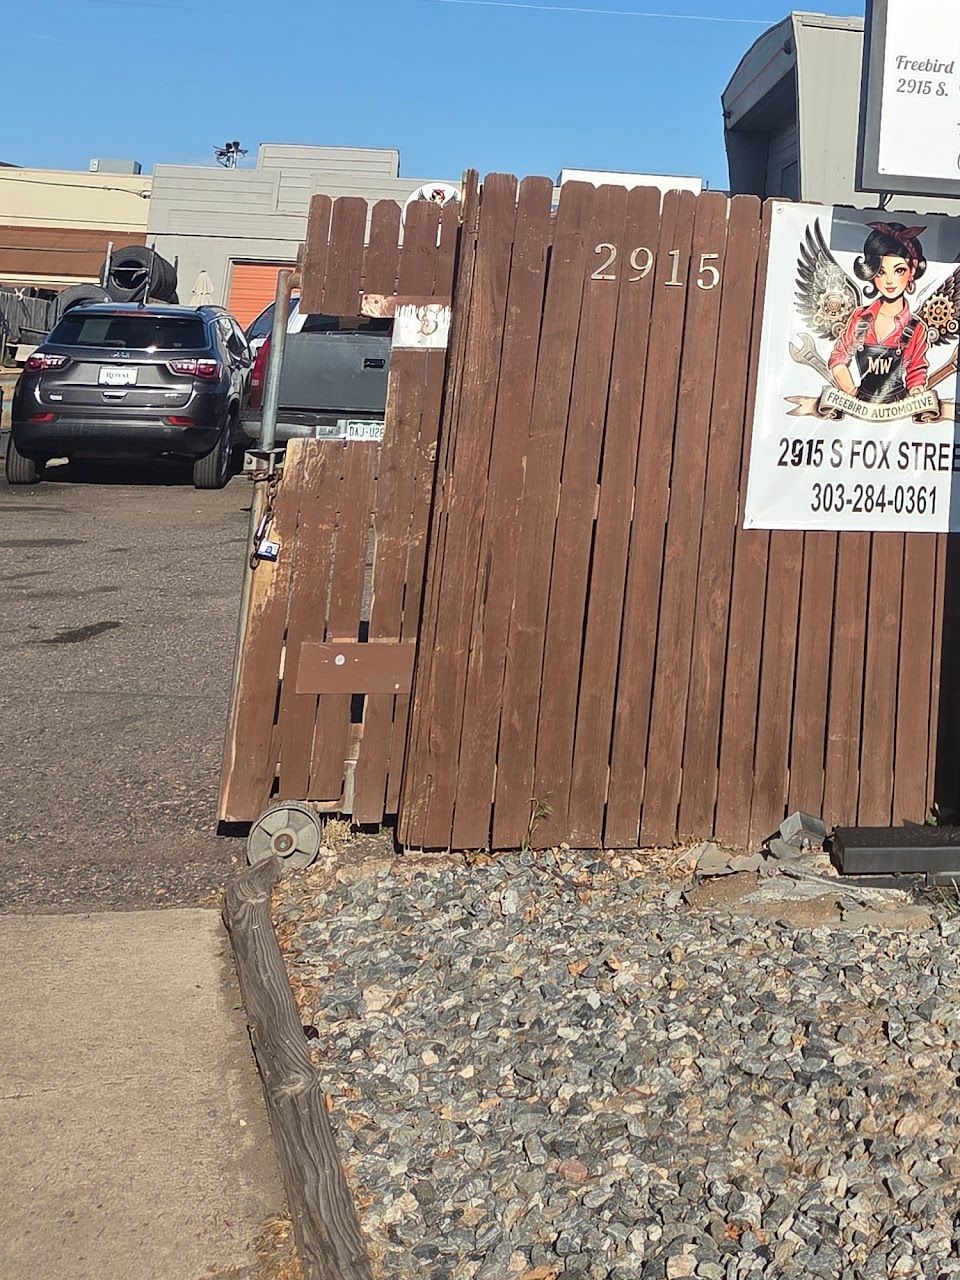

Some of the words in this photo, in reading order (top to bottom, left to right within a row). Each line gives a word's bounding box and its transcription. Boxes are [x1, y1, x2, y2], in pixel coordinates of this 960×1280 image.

[895, 55, 955, 74] Freebird
[896, 78, 932, 95] 2915
[935, 81, 948, 97] S.
[590, 242, 721, 290] 2915
[867, 356, 894, 375] MW
[827, 392, 869, 416] FREEBIRD
[871, 396, 934, 419] AUTOMOTIVE
[777, 437, 824, 467] 2915
[830, 438, 843, 468] S
[850, 440, 892, 470] FOX
[811, 483, 937, 514] 303-284-0361
